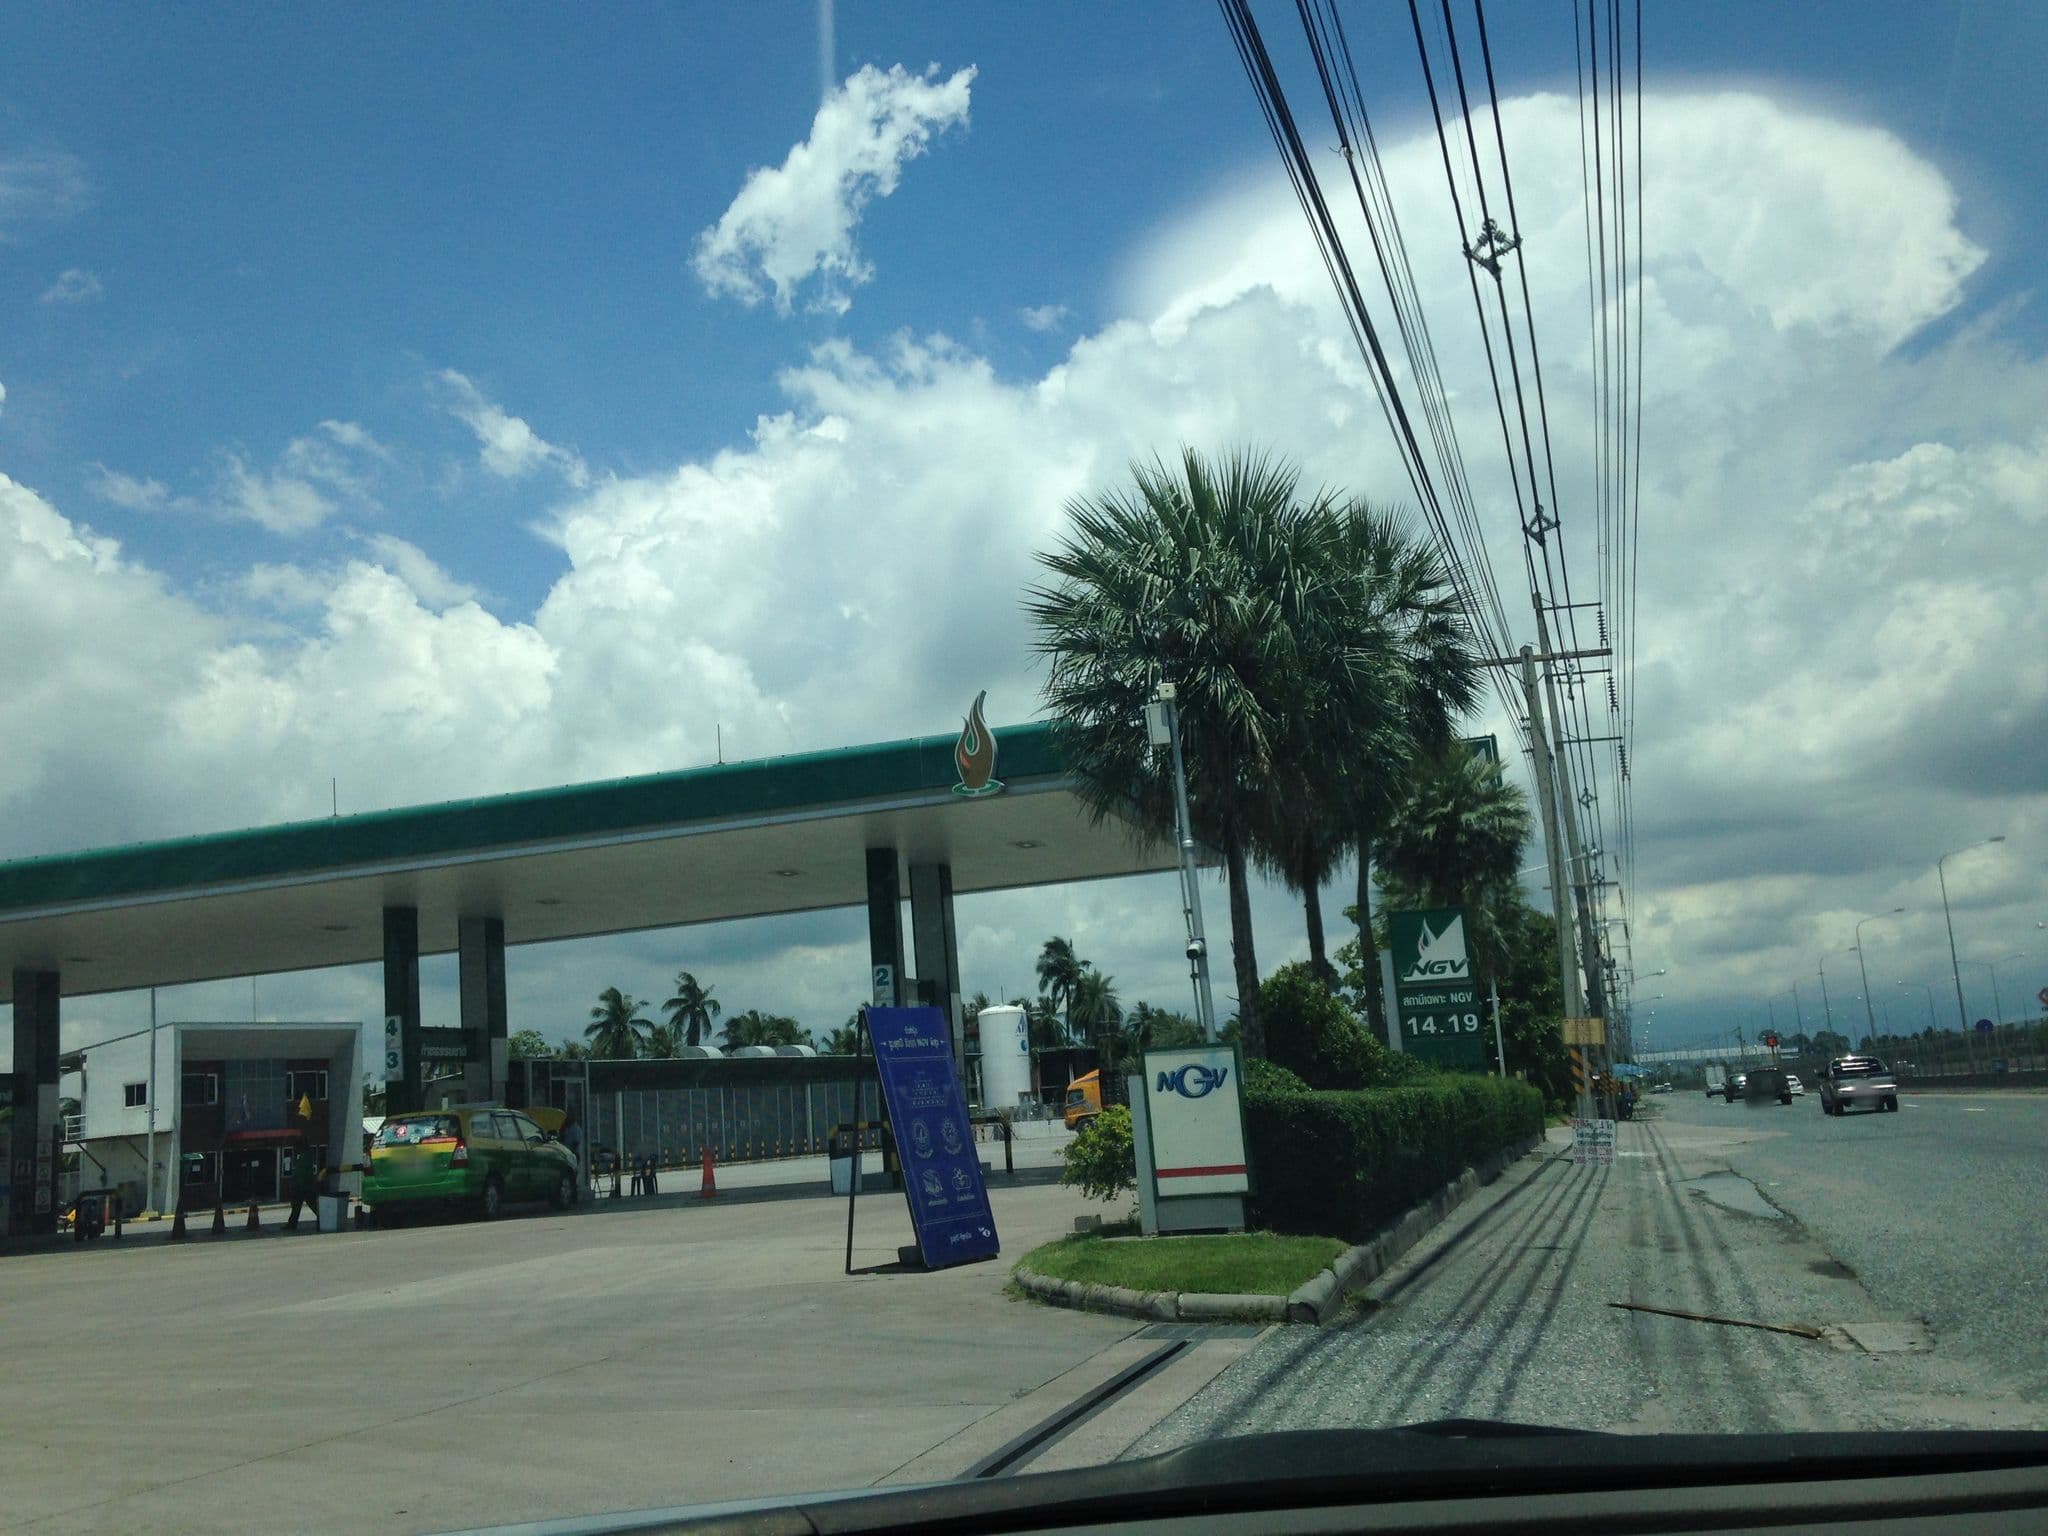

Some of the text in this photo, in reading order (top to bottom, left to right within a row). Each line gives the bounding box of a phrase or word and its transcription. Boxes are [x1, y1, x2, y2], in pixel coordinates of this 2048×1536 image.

[1401, 957, 1470, 976] NGV
[875, 968, 889, 986] 2
[1450, 992, 1473, 1004] NGV
[386, 1019, 398, 1036] 4
[1407, 1014, 1479, 1035] 14.19
[386, 1052, 399, 1069] 3
[1156, 1063, 1228, 1098] NGV
